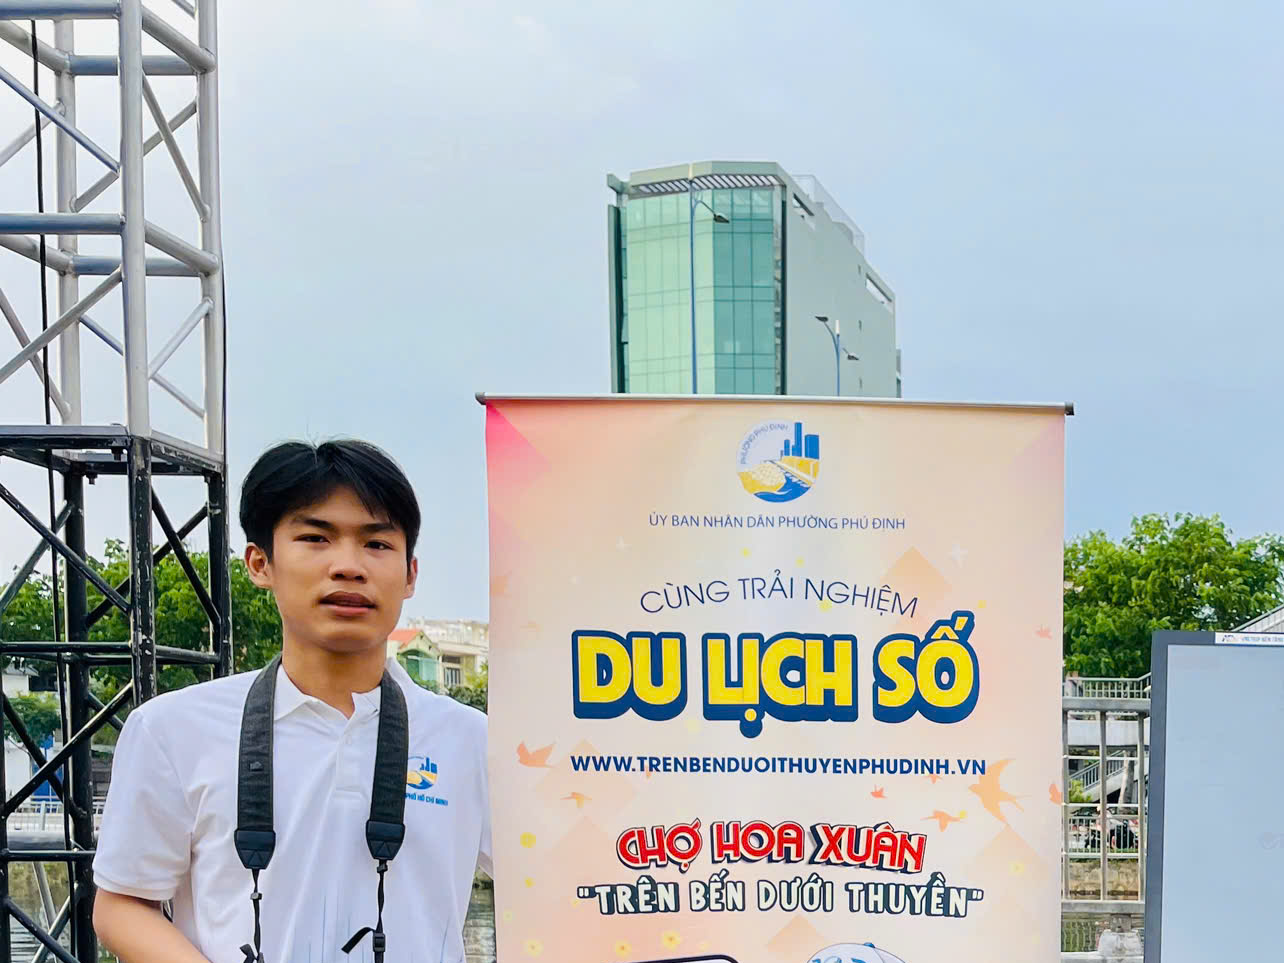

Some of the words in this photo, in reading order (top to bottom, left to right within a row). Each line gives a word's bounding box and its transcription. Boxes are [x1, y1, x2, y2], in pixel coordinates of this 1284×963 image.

[649, 512, 668, 527] ỦY
[672, 515, 700, 528] BAN
[703, 514, 743, 528] NHÂN
[747, 514, 775, 528] DÂN
[778, 514, 838, 530] PHƯỜNG
[842, 516, 869, 530] PHÚ
[872, 517, 906, 532] ĐỊNH
[640, 579, 730, 613] CÙNG
[737, 568, 794, 600] TRẢI
[804, 577, 918, 619] NGHIỆM
[573, 632, 685, 712] DU
[703, 634, 857, 726] LỊCH
[873, 613, 977, 714] SỐ
[570, 755, 986, 776] WWW.TRENBENDUOITHUYENPHUDINH.VN
[616, 817, 702, 873] CHỢ
[711, 820, 805, 864] HOA
[809, 822, 927, 873] XUÂN
[577, 874, 680, 915] "TRÊN
[689, 869, 745, 912] BẾN
[757, 872, 833, 912] DƯỚI
[844, 871, 984, 917] THUYỀN"
